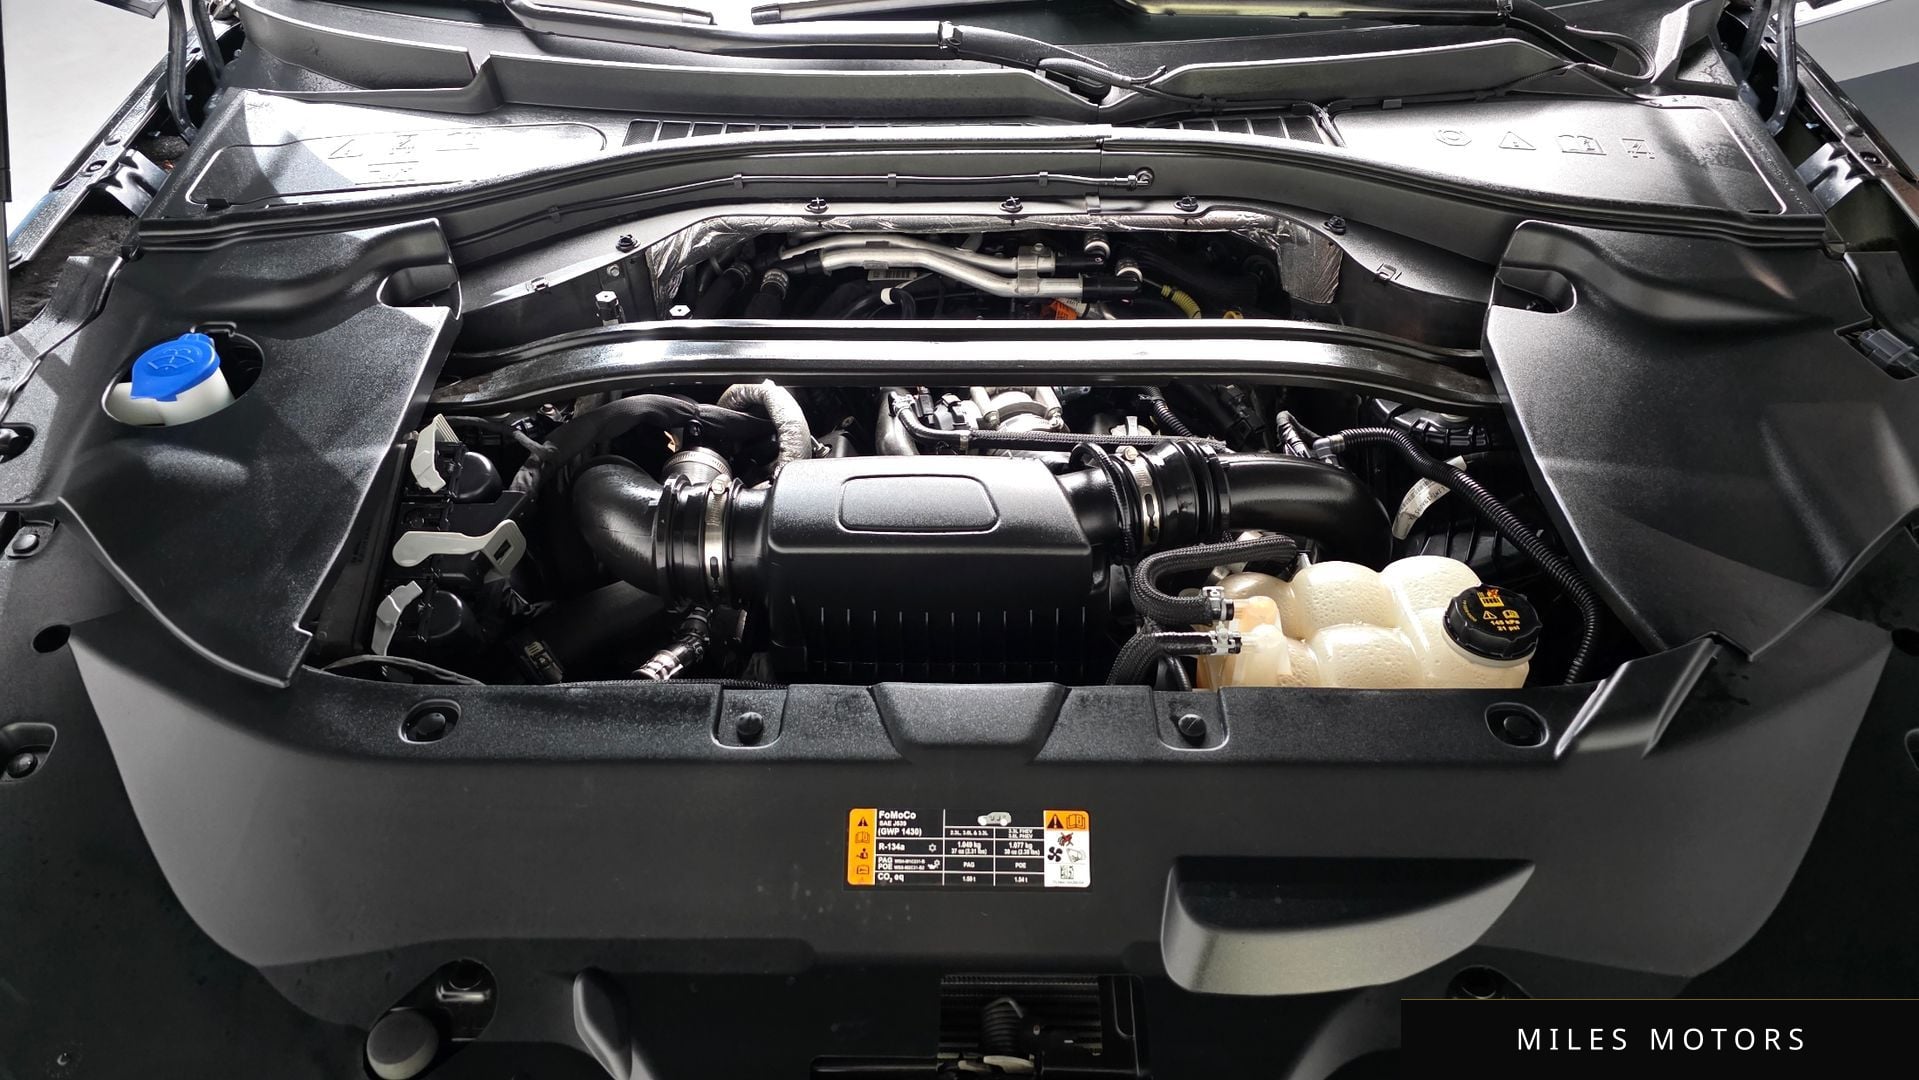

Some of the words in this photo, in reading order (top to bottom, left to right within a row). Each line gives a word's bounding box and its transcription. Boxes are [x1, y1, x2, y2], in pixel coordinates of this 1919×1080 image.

[879, 810, 917, 819] FoMoCo
[878, 828, 900, 836] (GWP
[901, 828, 922, 837] 1430)
[878, 842, 906, 851] R-134a
[973, 841, 982, 850] kg
[1024, 842, 1033, 851] kg
[894, 874, 905, 883] eq
